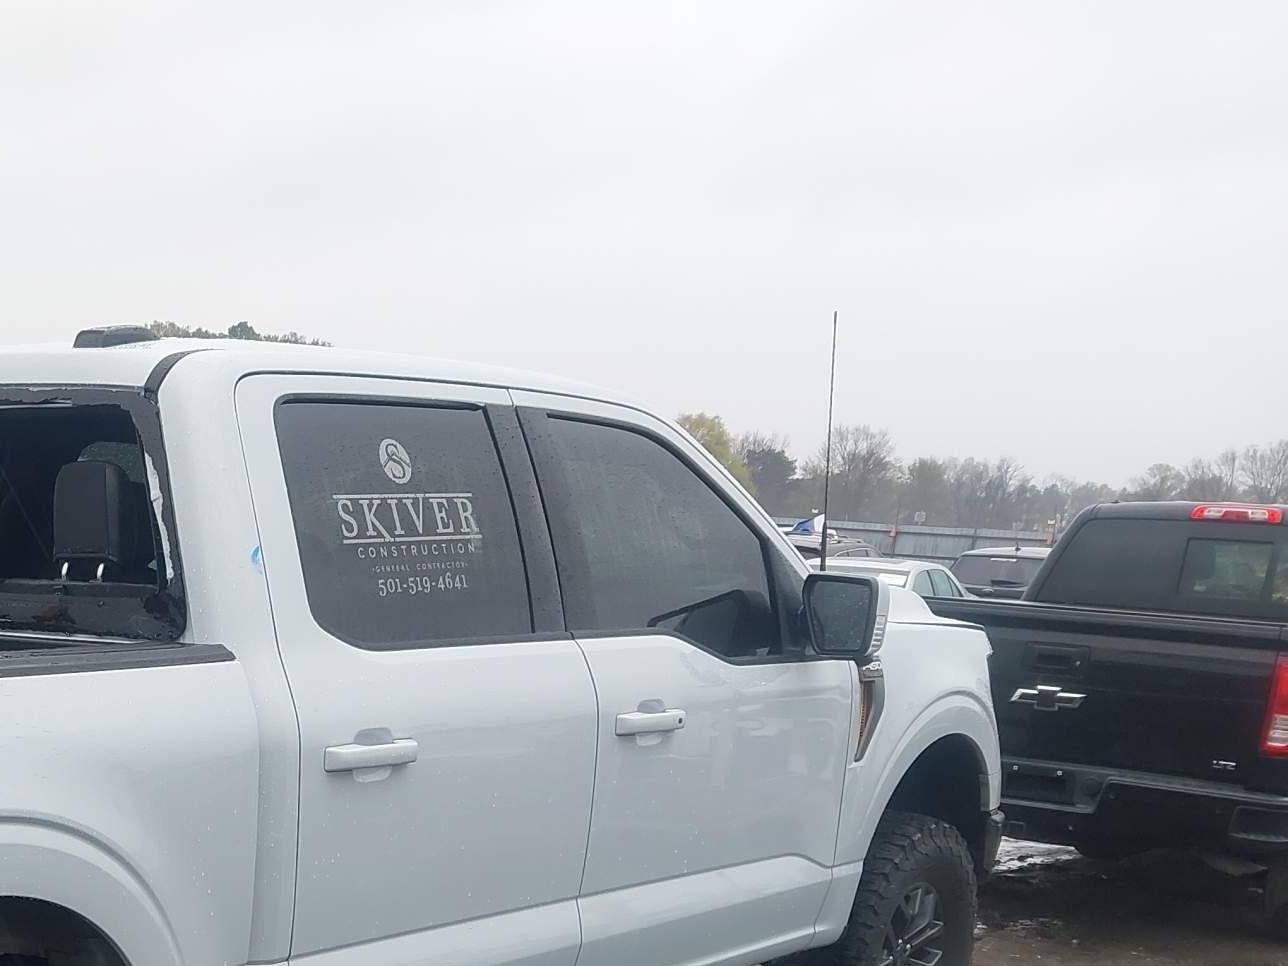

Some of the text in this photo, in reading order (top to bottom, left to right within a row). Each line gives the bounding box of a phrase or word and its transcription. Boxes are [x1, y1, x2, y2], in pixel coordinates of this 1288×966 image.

[337, 497, 480, 541] SKIVER
[358, 543, 476, 558] CONSTRUCTION
[378, 572, 469, 597] 501-519-4641
